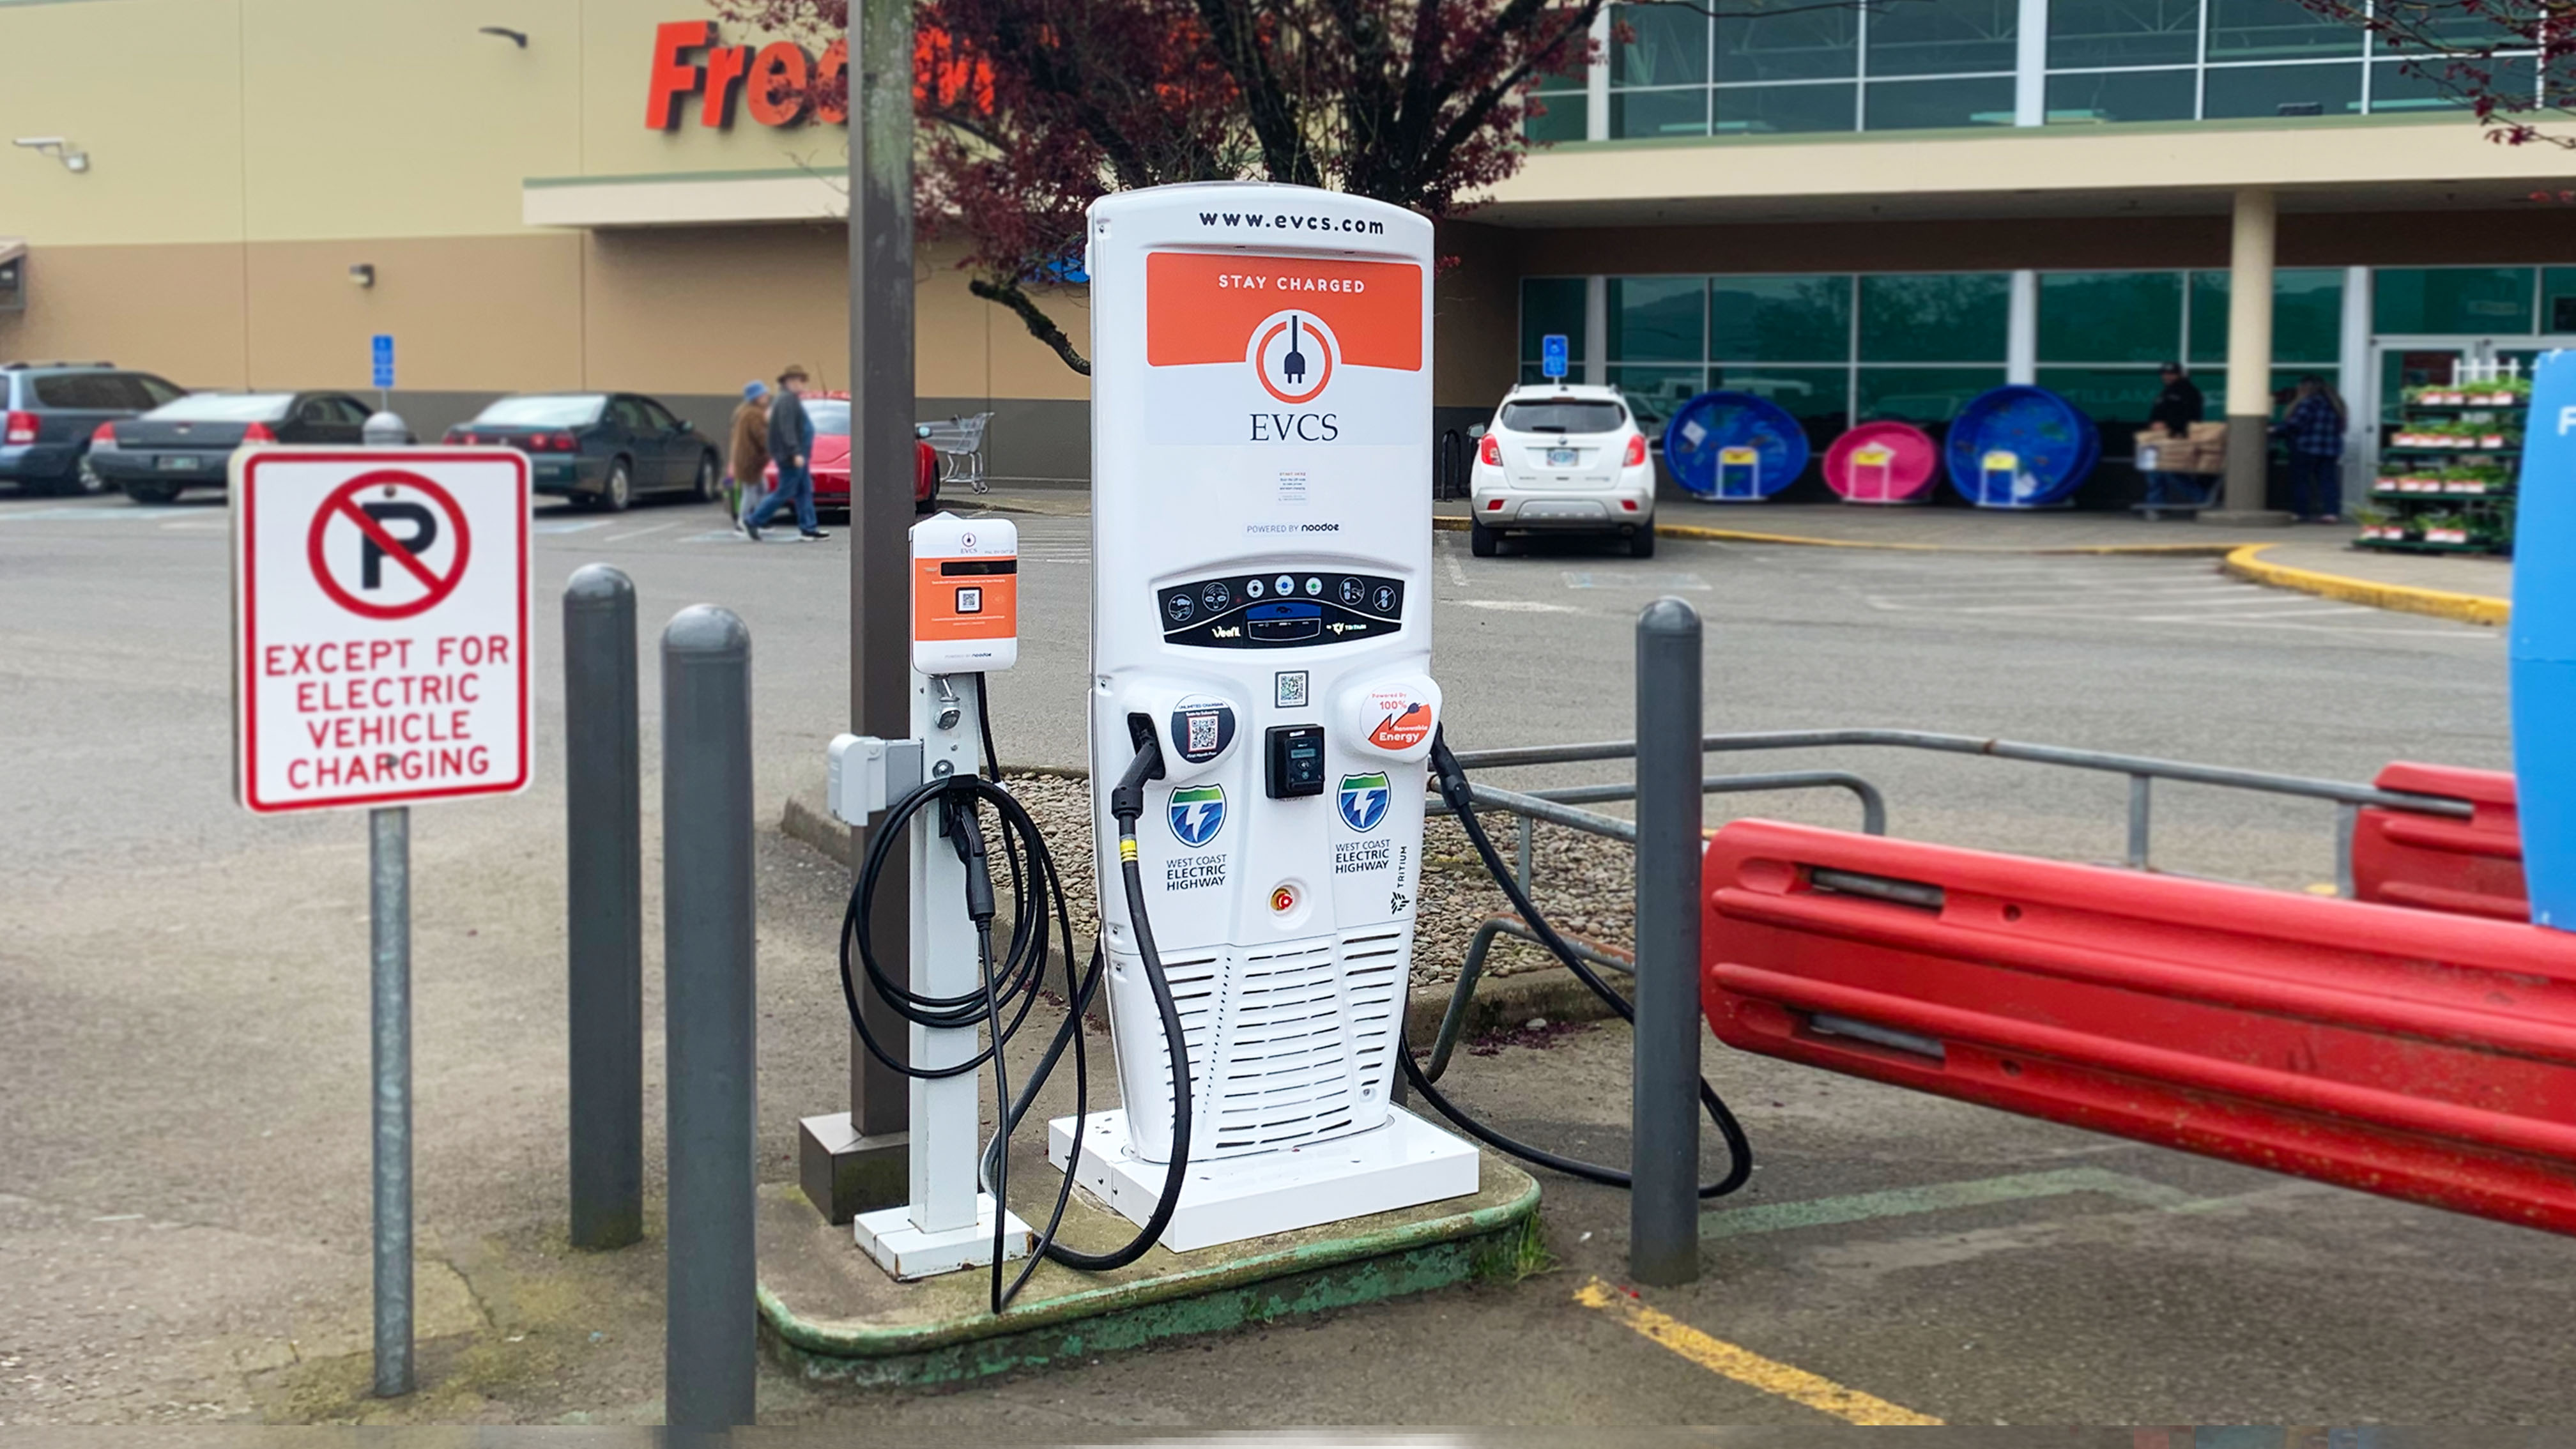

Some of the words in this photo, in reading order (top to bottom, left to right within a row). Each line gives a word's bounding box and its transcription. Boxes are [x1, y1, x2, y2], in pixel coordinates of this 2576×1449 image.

[1199, 211, 1384, 234] www.evcs.com
[1218, 275, 1266, 290] STAY
[1277, 276, 1365, 294] CHARGED
[1249, 413, 1339, 442] EVCS
[1247, 524, 1287, 534] POWERED
[1289, 524, 1300, 533] BY
[1301, 522, 1340, 533] noodoe
[265, 639, 413, 676] EXCEPT
[437, 635, 510, 667] FOR
[297, 673, 480, 713] ELECTRIC
[1380, 700, 1407, 710] 100%
[307, 710, 471, 749] VEHICLE
[1379, 732, 1419, 743] Energy
[288, 746, 489, 790] CHARGING
[1336, 843, 1360, 852] WEST
[1363, 839, 1390, 850] COAST
[1167, 857, 1193, 868] WEST
[1196, 854, 1227, 865] COAST
[1336, 848, 1389, 863] ELECTRIC
[1167, 864, 1225, 880] ELECTRIC
[1336, 860, 1389, 874] HIGHWAY
[1397, 846, 1407, 888] TRITIUM
[1167, 876, 1225, 891] HIGHWAY
